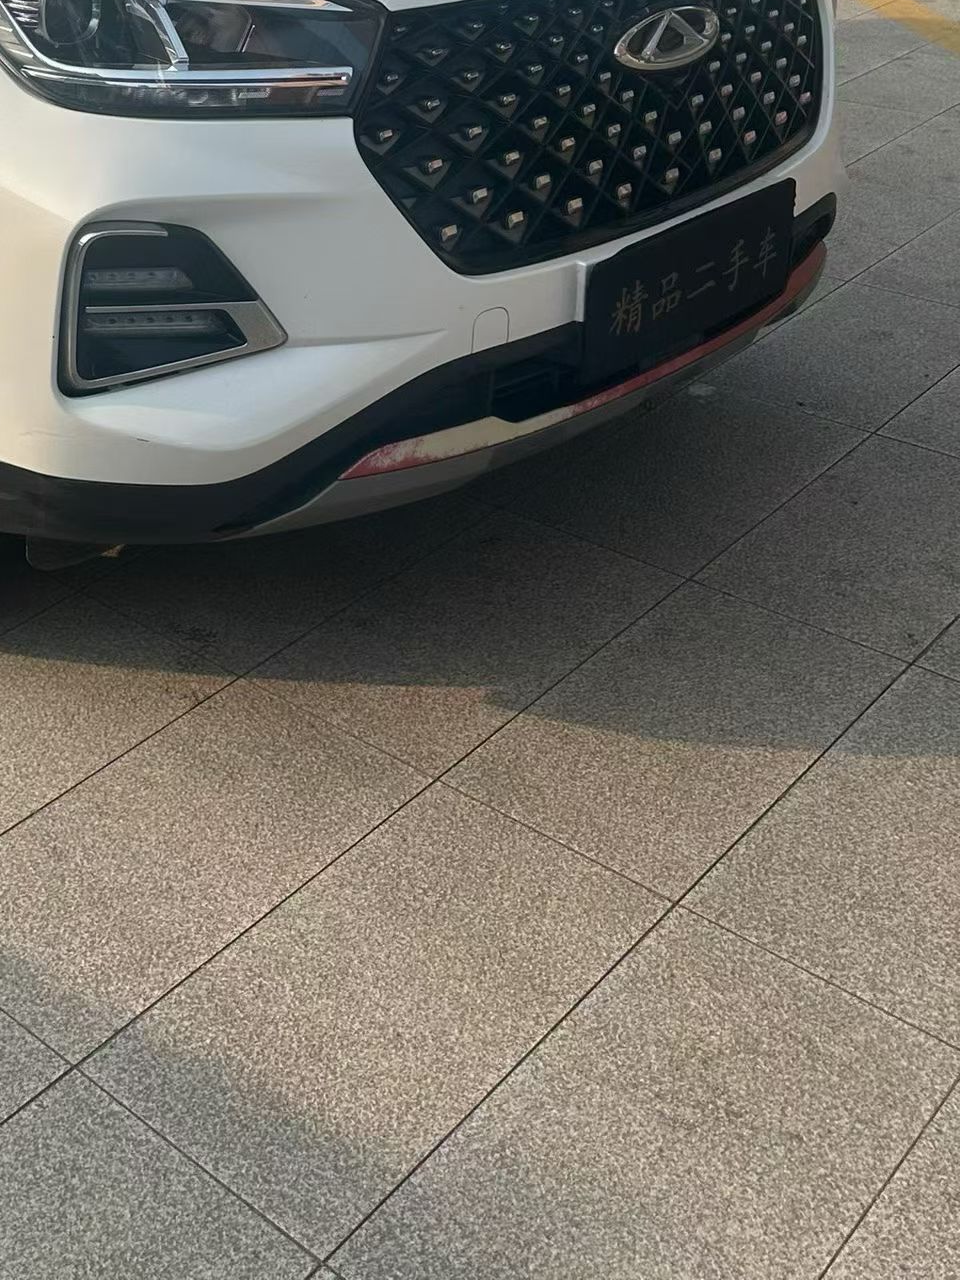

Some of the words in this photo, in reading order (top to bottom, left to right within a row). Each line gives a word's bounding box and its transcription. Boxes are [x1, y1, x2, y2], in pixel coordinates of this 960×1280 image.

[609, 227, 776, 335] 精品二手车
